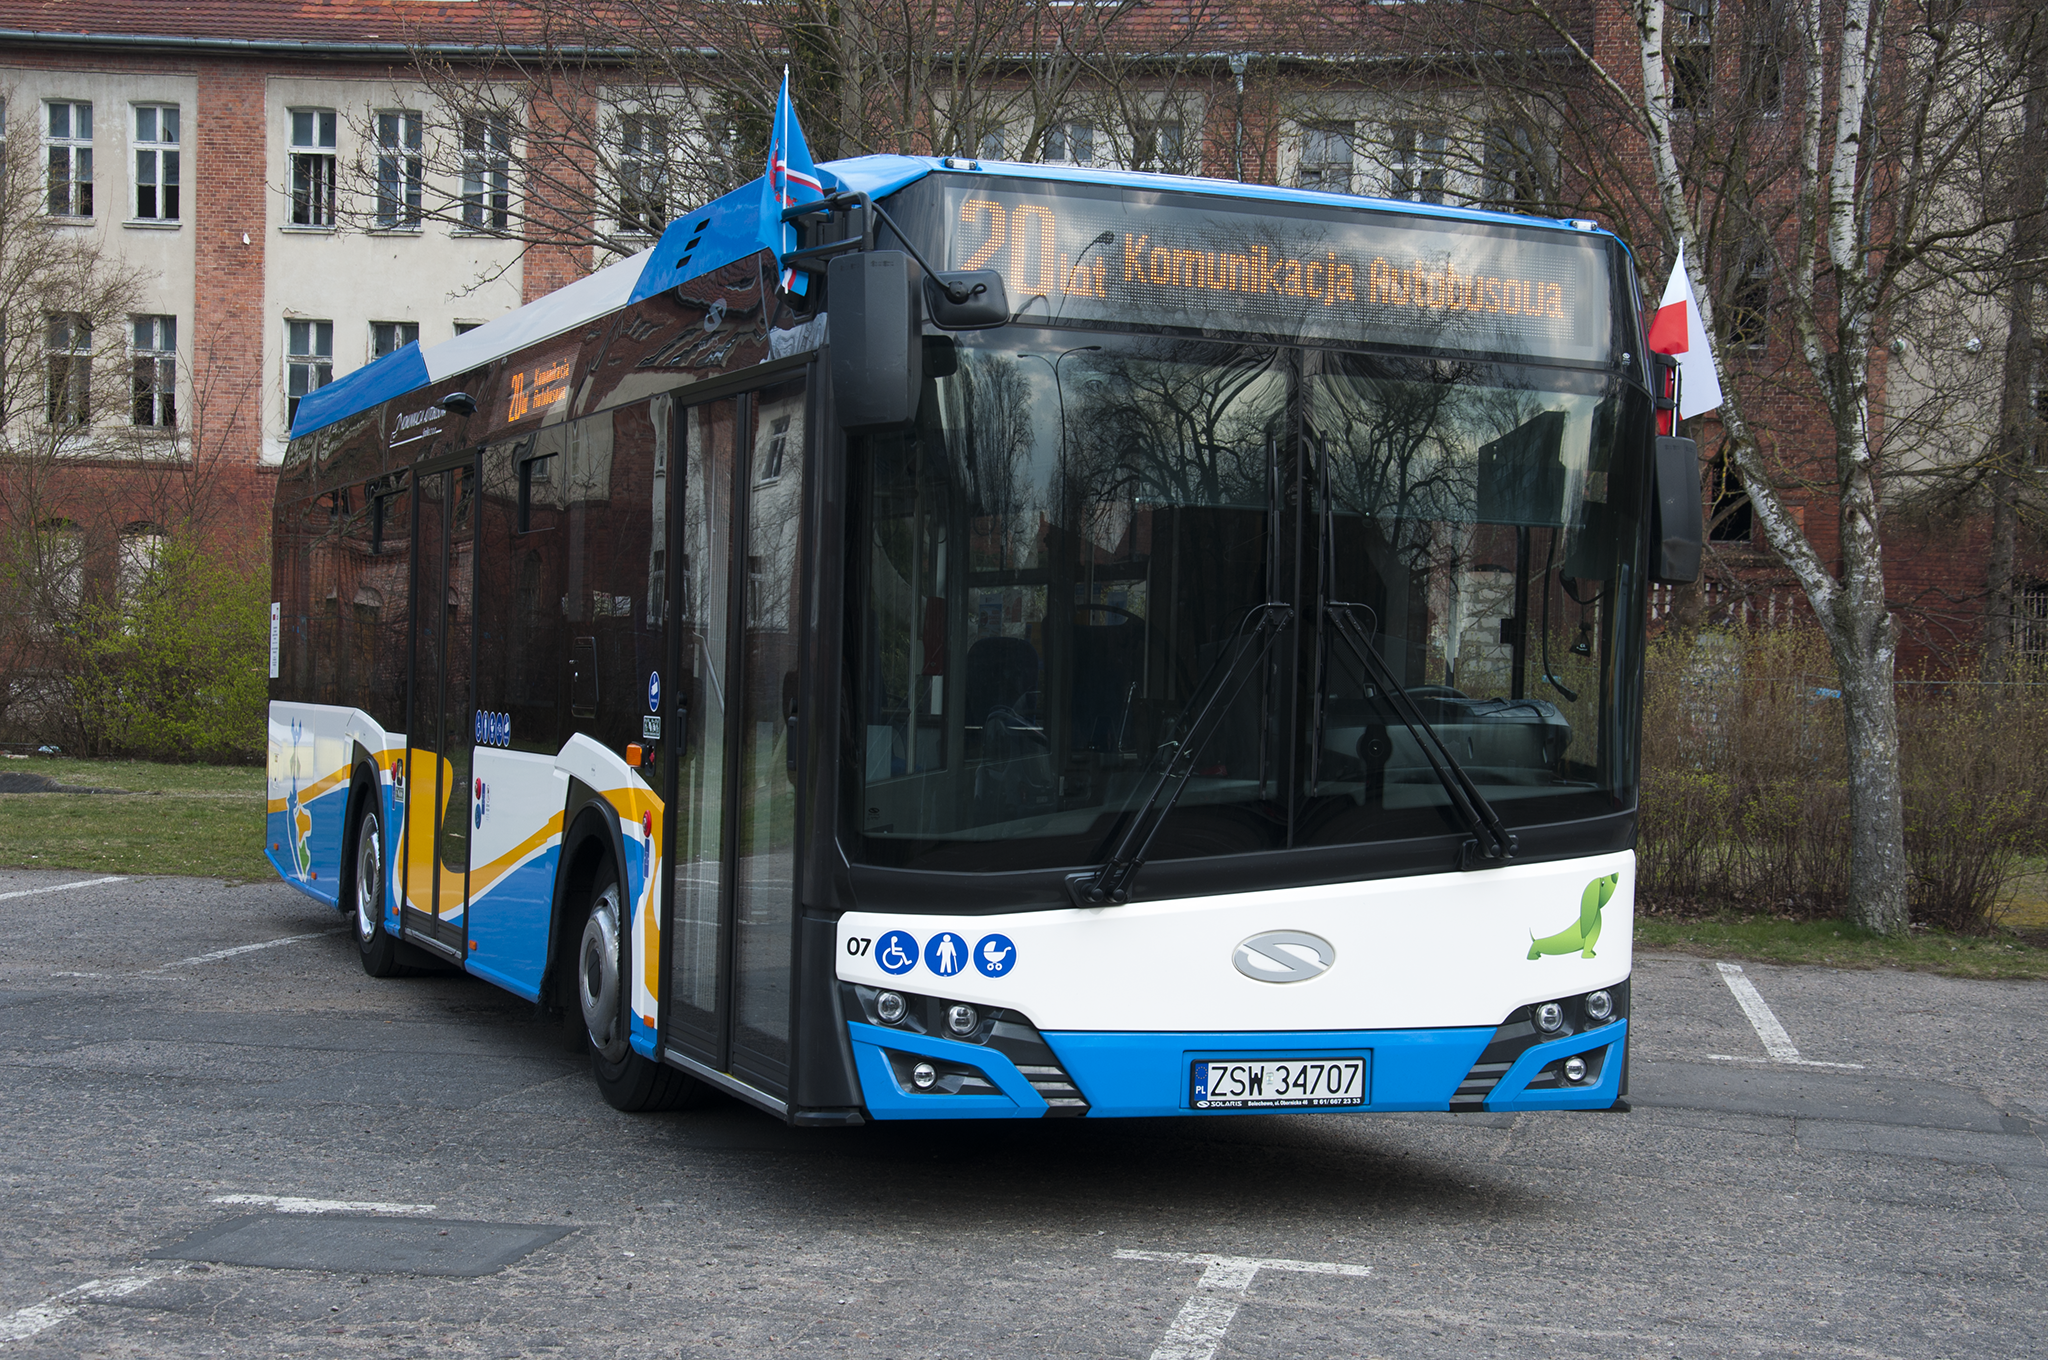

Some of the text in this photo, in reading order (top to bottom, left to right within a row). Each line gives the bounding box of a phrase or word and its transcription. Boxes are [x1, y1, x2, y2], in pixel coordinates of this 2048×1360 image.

[960, 198, 1565, 319] 20 lat Komunikacja Autobusowa
[508, 372, 524, 422] 20
[846, 936, 872, 957] 07
[1196, 1085, 1207, 1095] PL
[1210, 1064, 1360, 1097] ZSW 34707
